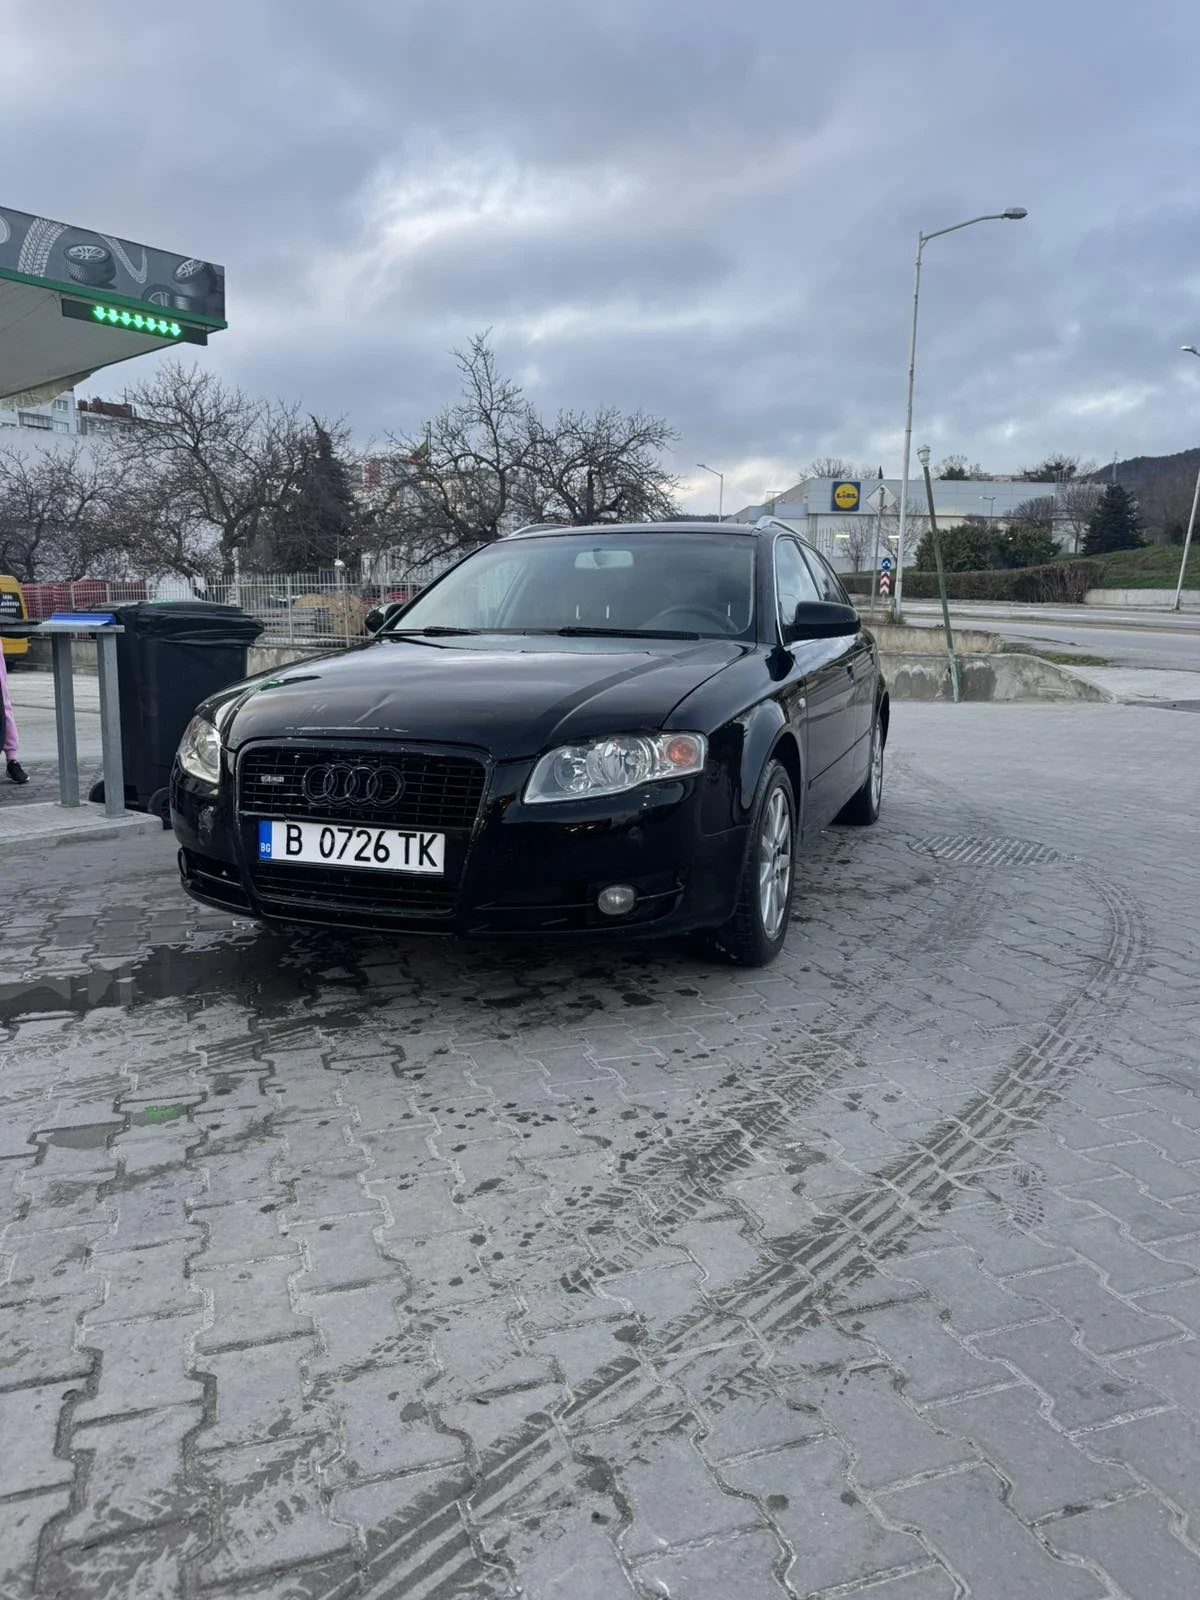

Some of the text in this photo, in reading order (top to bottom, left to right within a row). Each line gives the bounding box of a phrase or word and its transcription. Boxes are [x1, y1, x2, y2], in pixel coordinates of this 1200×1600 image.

[260, 842, 271, 853] BG
[286, 824, 438, 867] B 0726 TK
